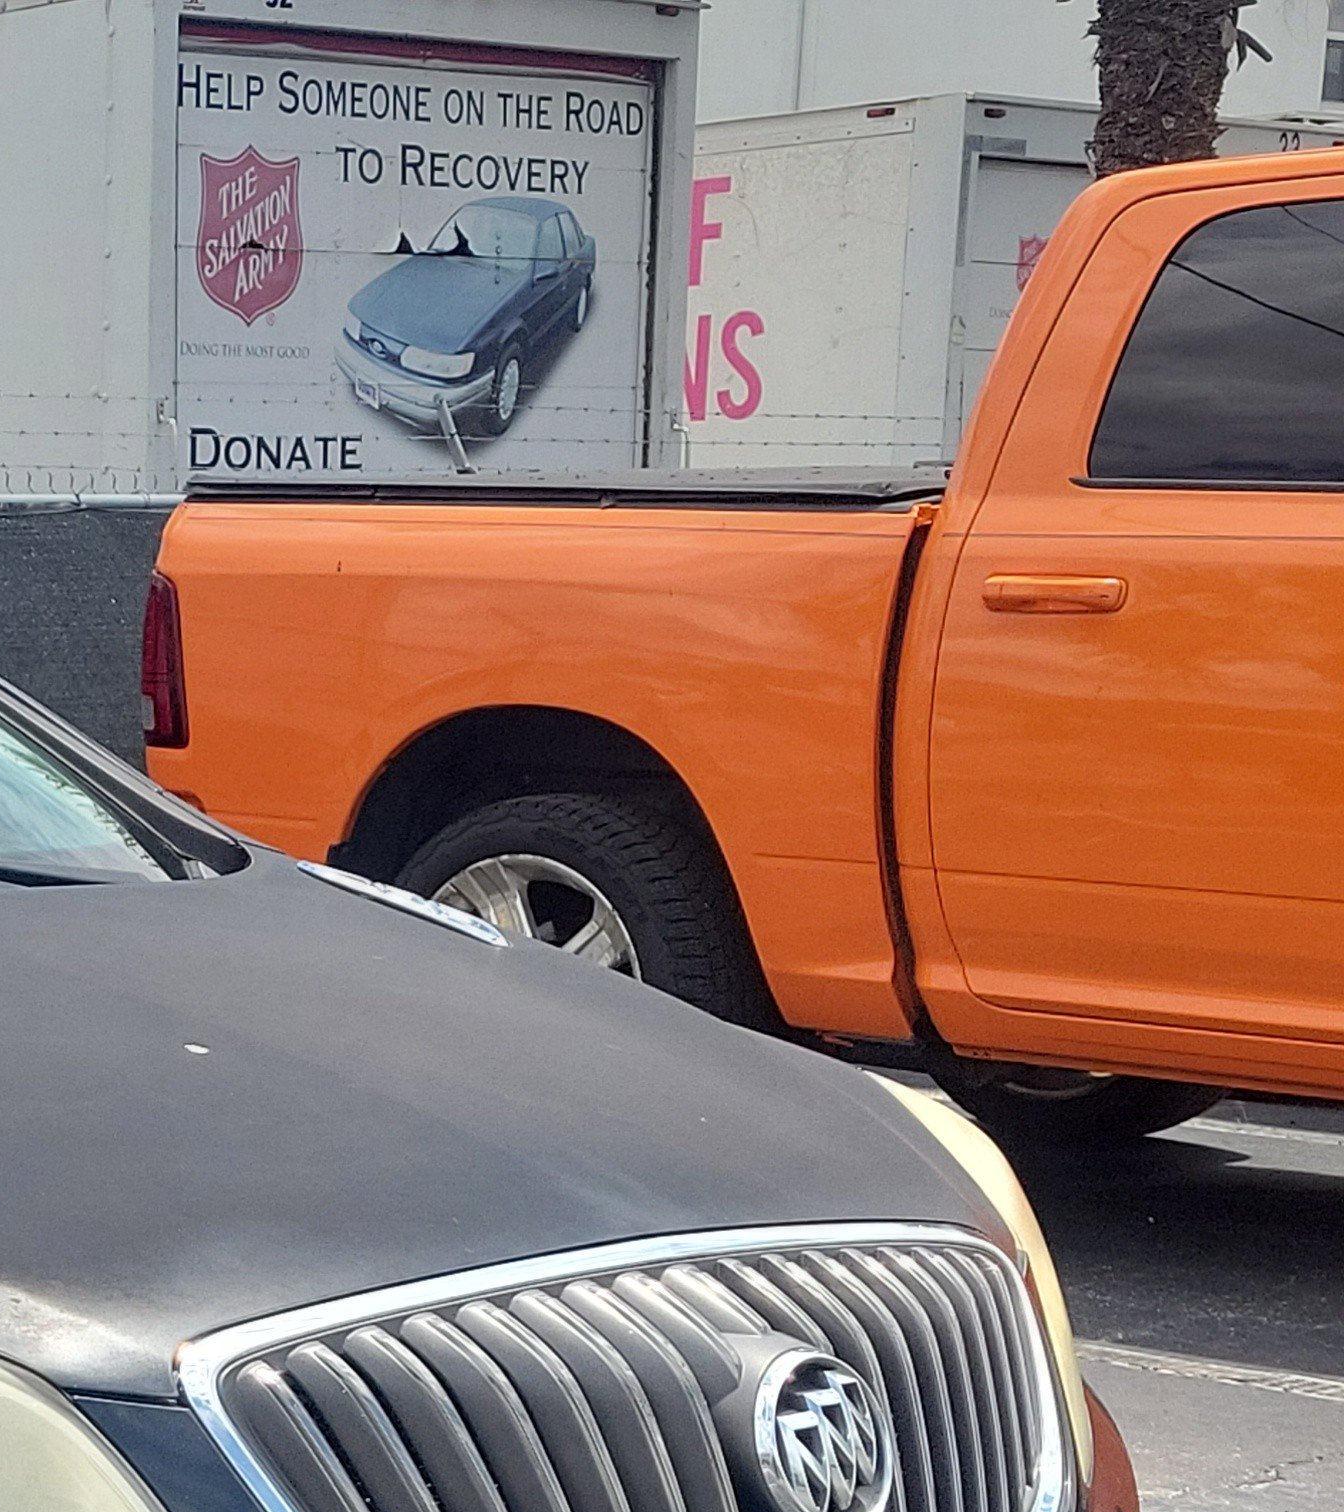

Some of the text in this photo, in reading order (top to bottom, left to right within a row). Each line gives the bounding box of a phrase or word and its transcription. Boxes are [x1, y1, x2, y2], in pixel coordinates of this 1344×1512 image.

[177, 62, 645, 137] HELP SOMEONE ON THE ROAD
[217, 165, 259, 220] THE
[334, 143, 590, 196] TO RECOVERY
[203, 174, 292, 280] SALVATION
[233, 224, 289, 304] ARMY
[221, 343, 244, 358] THE
[189, 427, 364, 472] DONATE
